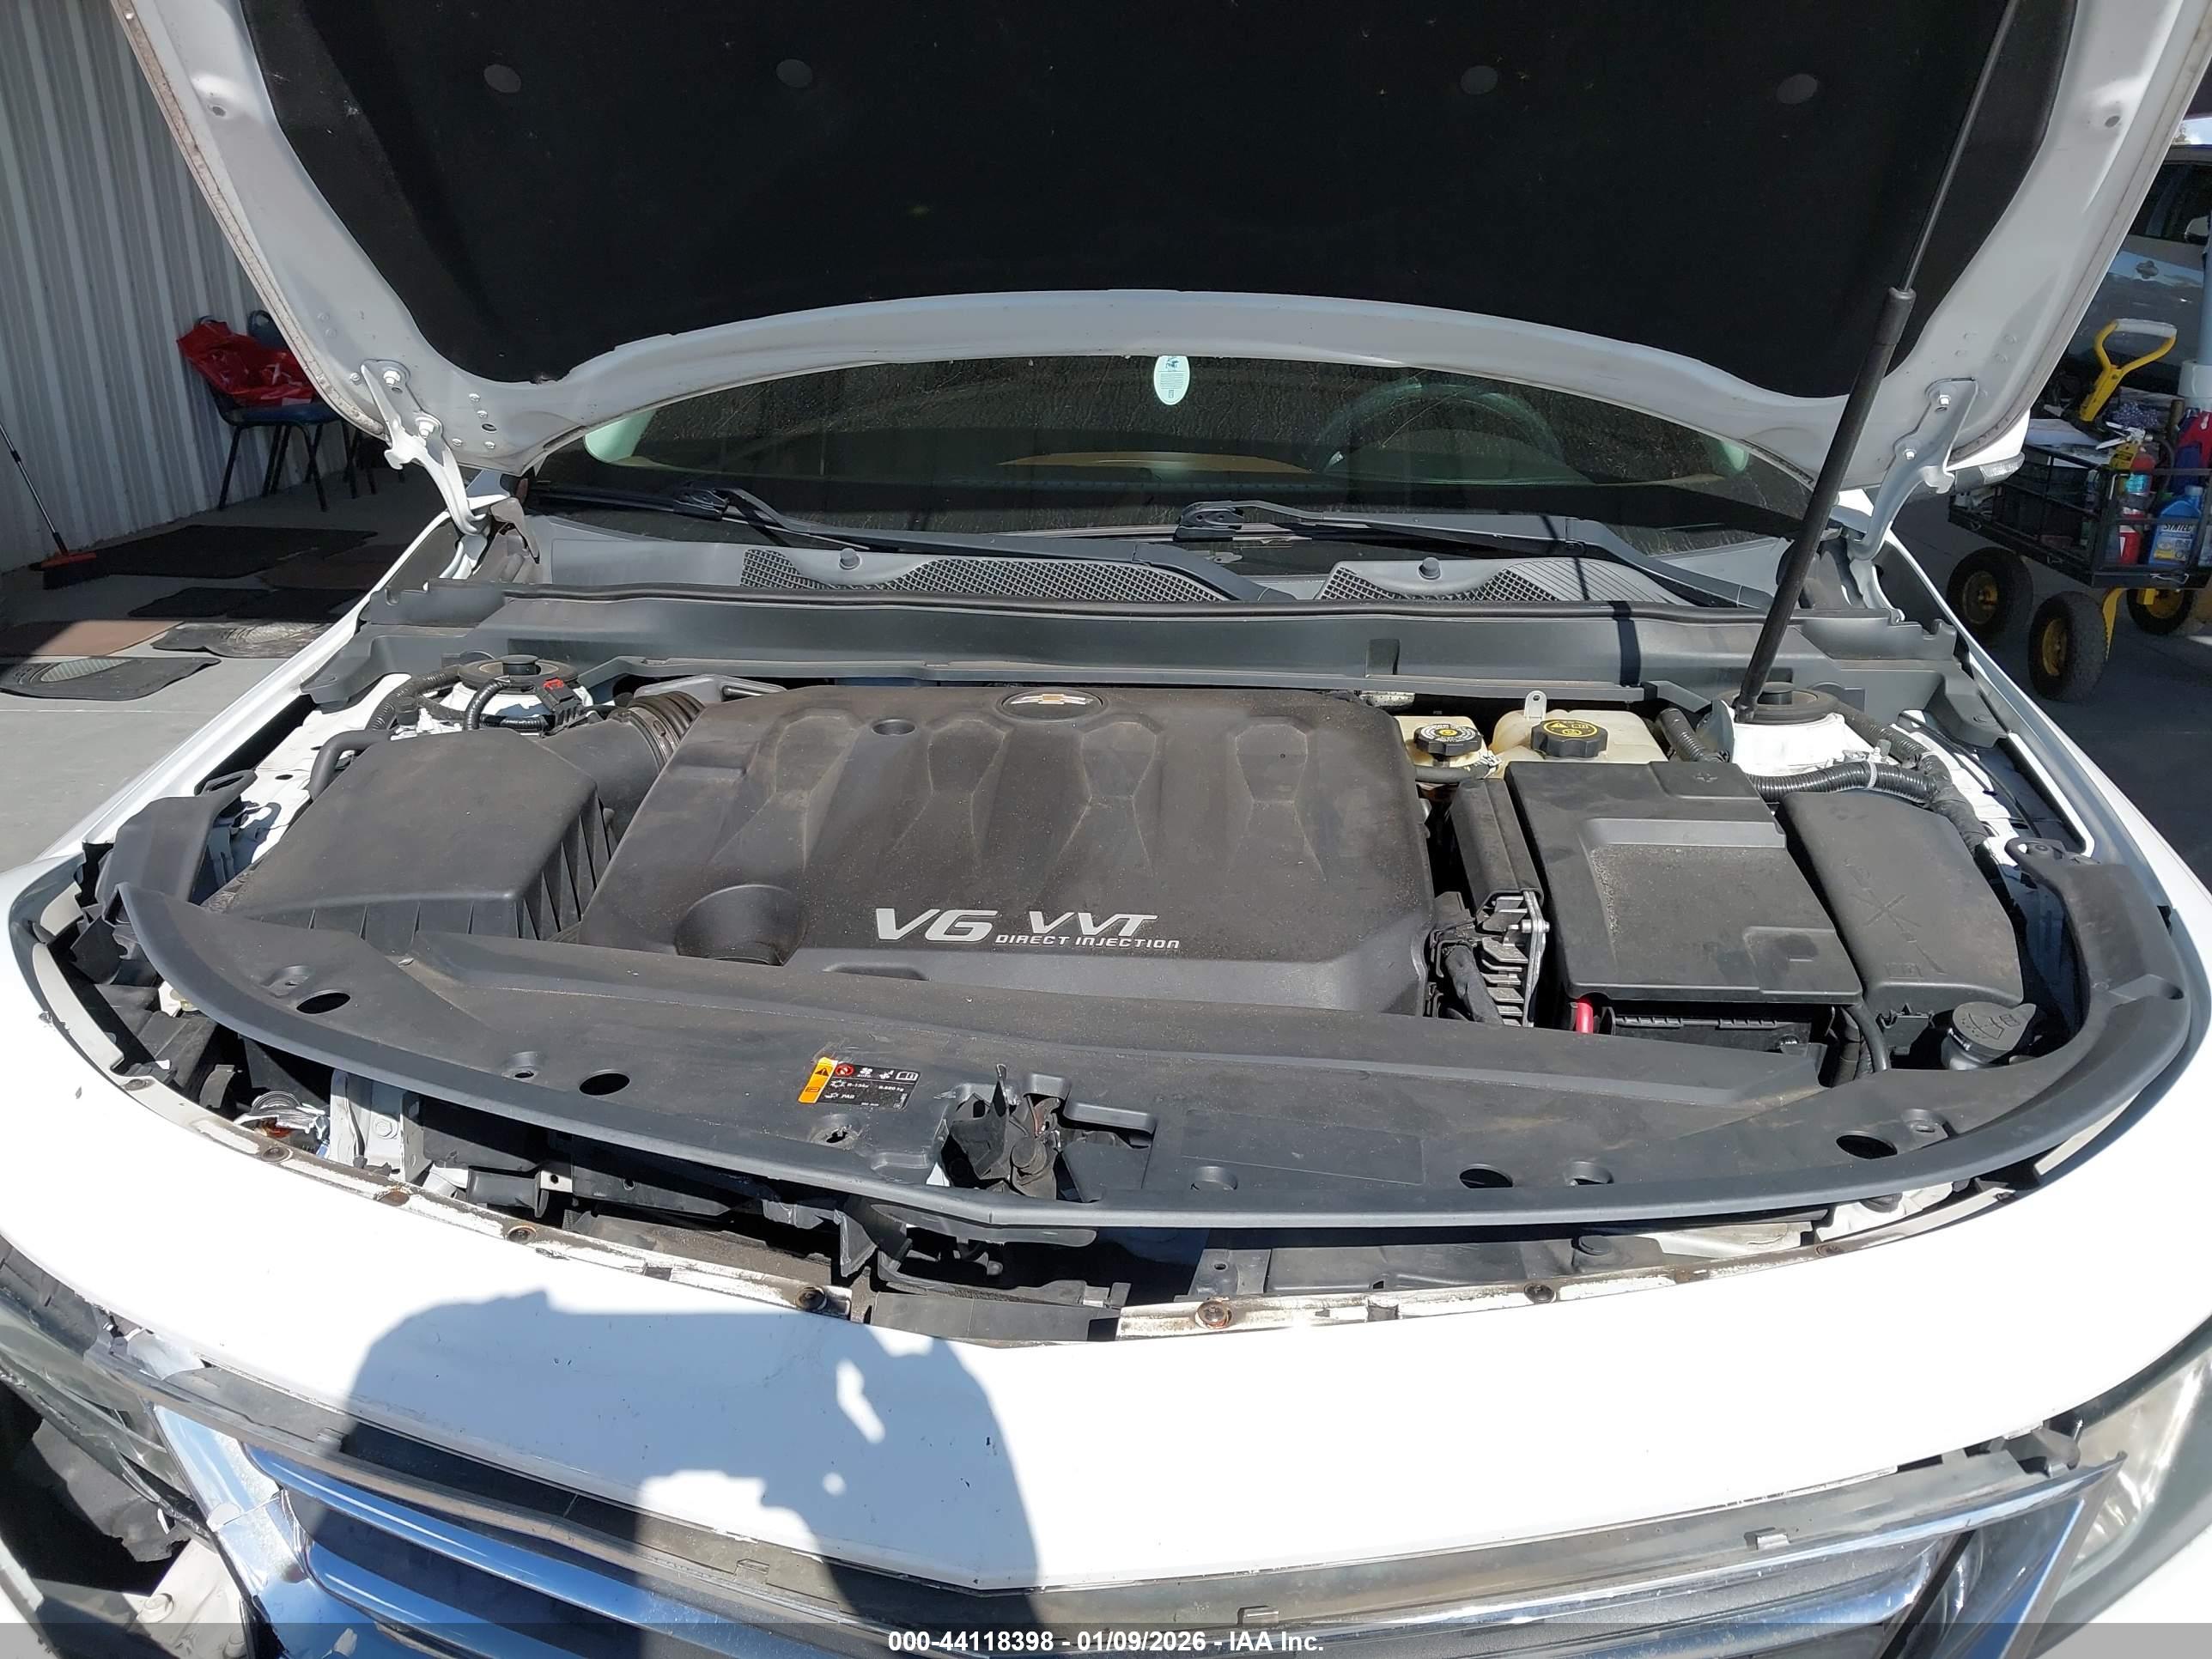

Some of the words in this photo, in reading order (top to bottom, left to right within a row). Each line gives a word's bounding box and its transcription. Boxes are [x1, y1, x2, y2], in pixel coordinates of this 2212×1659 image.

[876, 908, 998, 942] V6
[1030, 910, 1158, 937] VVT
[995, 934, 1071, 945] DIRECT
[1075, 936, 1180, 949] INJECTION
